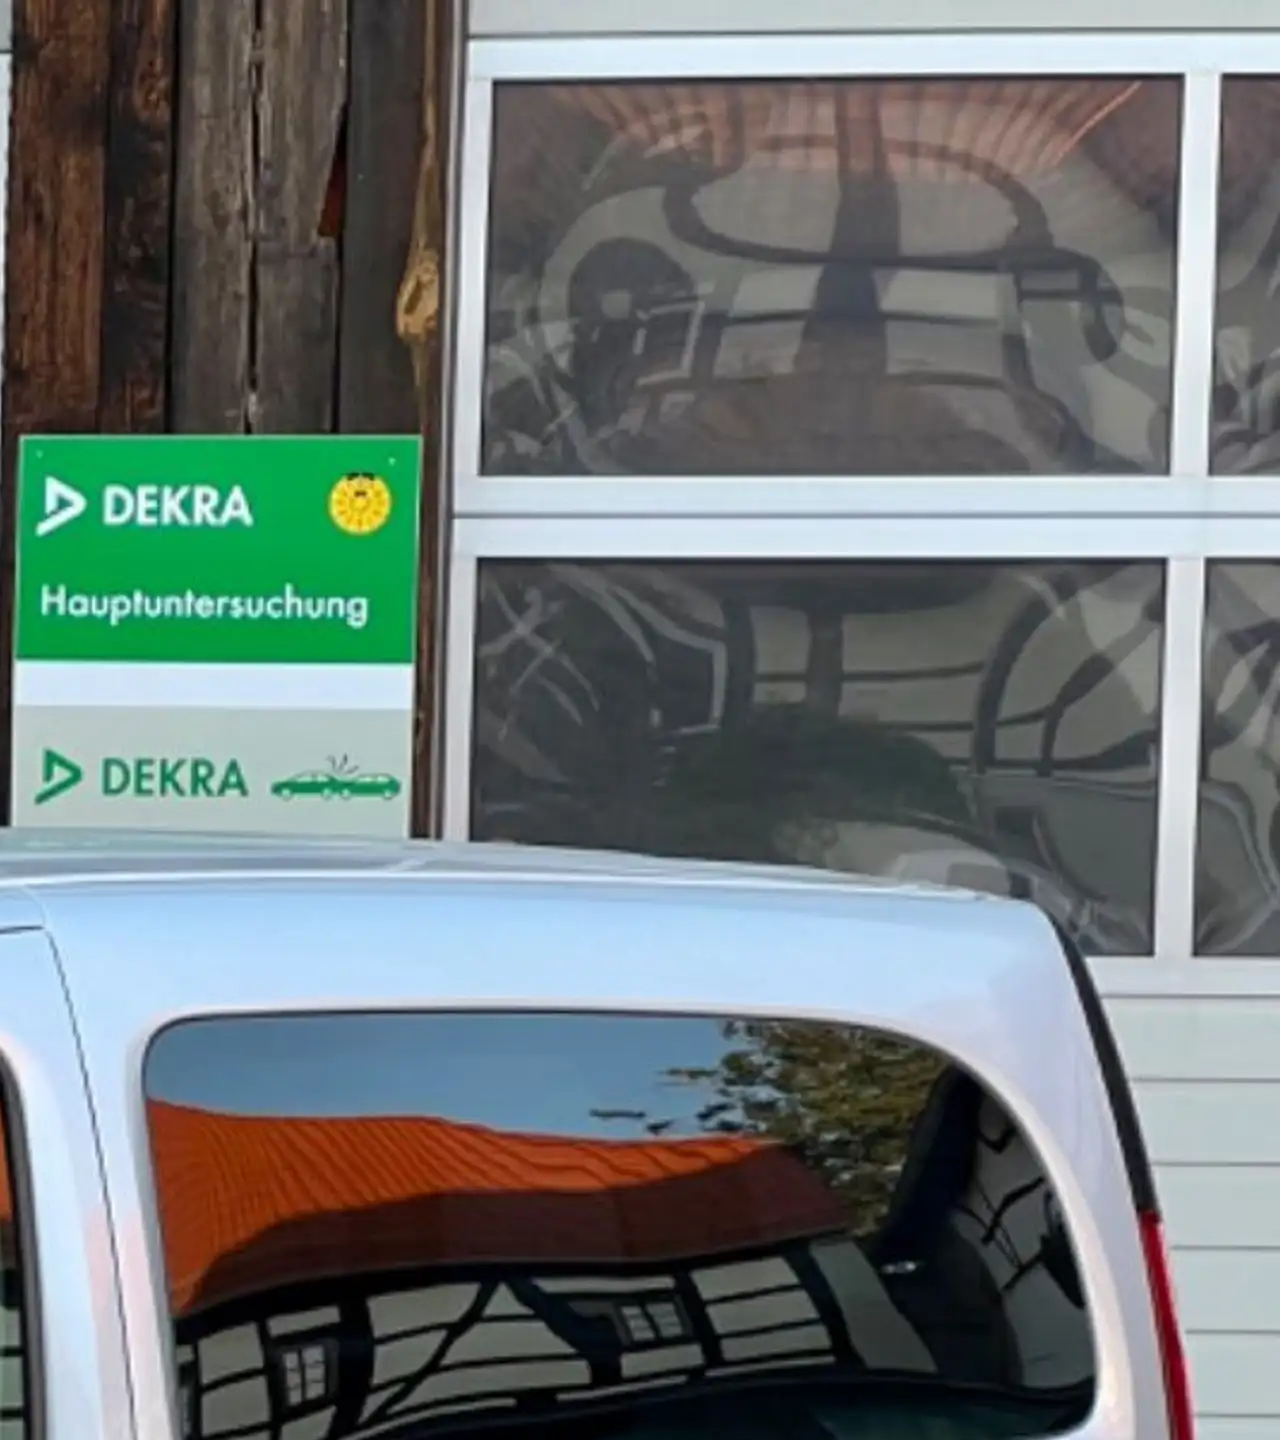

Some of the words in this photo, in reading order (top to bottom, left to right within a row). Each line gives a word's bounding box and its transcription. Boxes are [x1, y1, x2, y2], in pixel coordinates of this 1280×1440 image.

[103, 485, 253, 526] DEKRA
[41, 584, 368, 628] Hauptuntersuchung
[101, 757, 250, 798] DEKRA
